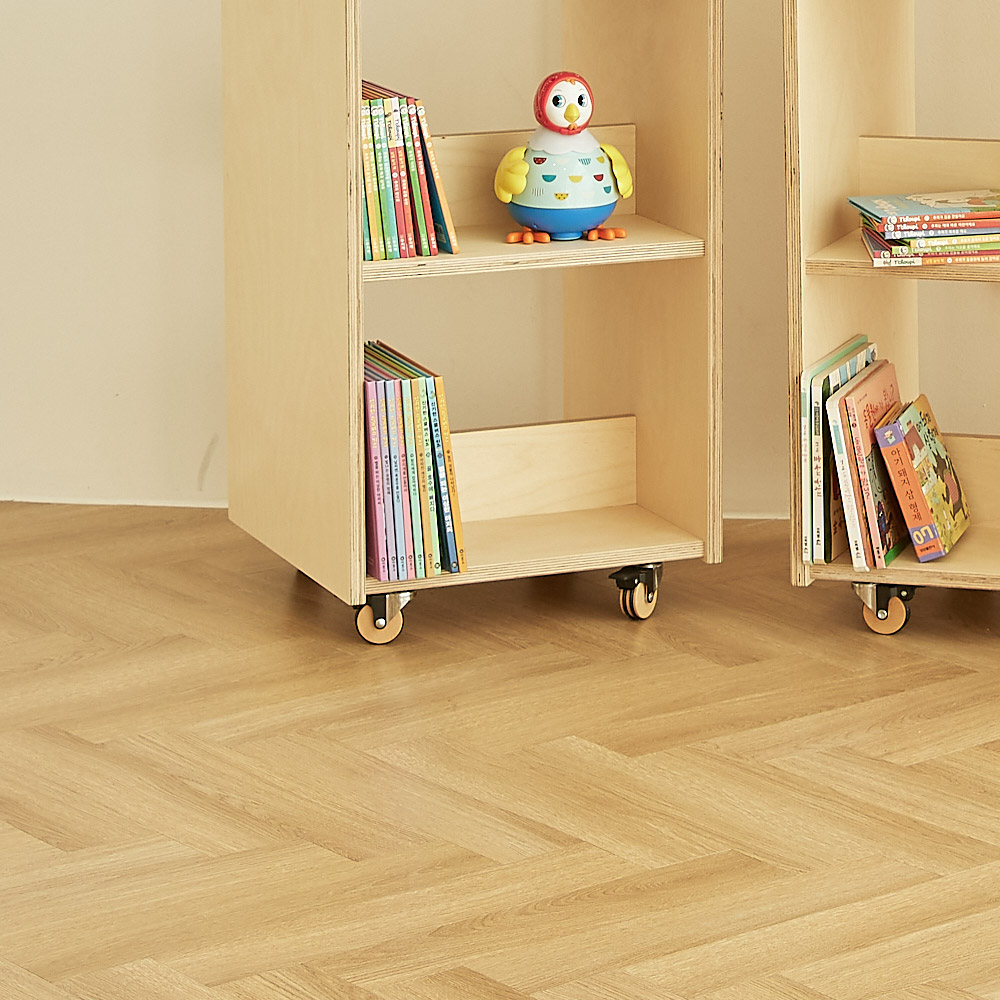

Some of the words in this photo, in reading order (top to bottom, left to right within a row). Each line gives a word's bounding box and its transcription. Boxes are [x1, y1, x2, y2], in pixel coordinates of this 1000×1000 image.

[891, 448, 904, 466] 아기
[897, 468, 911, 486] 돼지
[905, 490, 914, 500] 삼
[909, 502, 922, 521] 형제
[913, 525, 934, 544] 07
